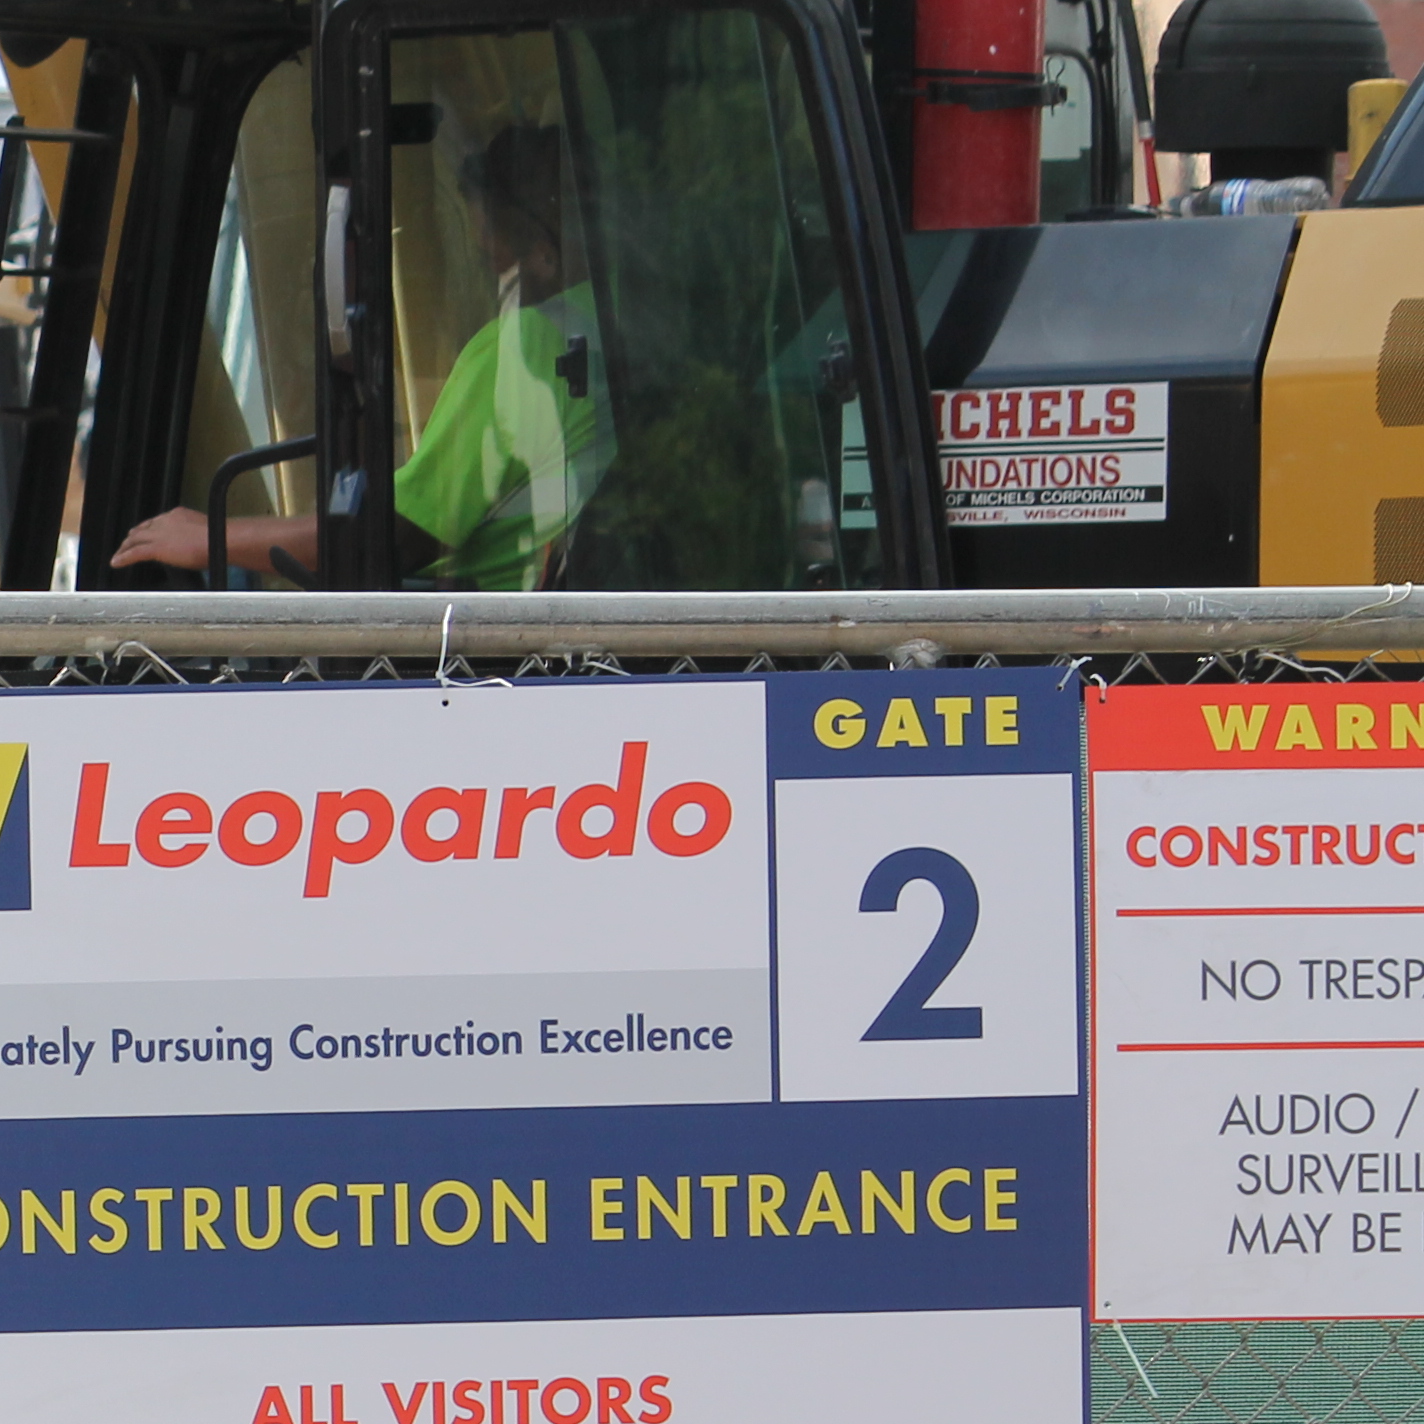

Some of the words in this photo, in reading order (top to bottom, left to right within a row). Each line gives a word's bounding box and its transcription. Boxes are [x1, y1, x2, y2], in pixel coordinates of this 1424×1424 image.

[932, 388, 1136, 440] ICHELS
[944, 454, 1122, 490] UNDATIONS
[946, 493, 965, 506] OF
[971, 491, 1035, 506] MICHELS
[1040, 488, 1146, 504] CORPORATION
[947, 511, 1008, 522] SVILLE,
[1023, 507, 1126, 519] WISCONSIN
[813, 696, 1019, 749] GATE
[1201, 703, 1424, 751] WARN
[69, 741, 732, 898] Leopardo
[858, 847, 983, 1041] 2
[1201, 959, 1282, 1001] NO
[1299, 958, 1424, 1000] TRESP
[111, 1025, 273, 1072] Pursuing
[289, 1020, 523, 1060] Construction
[540, 1012, 733, 1054] Excellence
[1219, 1092, 1375, 1136] AUDIO
[1395, 1088, 1420, 1139] /
[1237, 1152, 1424, 1196] SURVEILL
[590, 1167, 1018, 1241] ENTRANCE
[1227, 1212, 1332, 1255] MAY
[1352, 1212, 1402, 1253] BE
